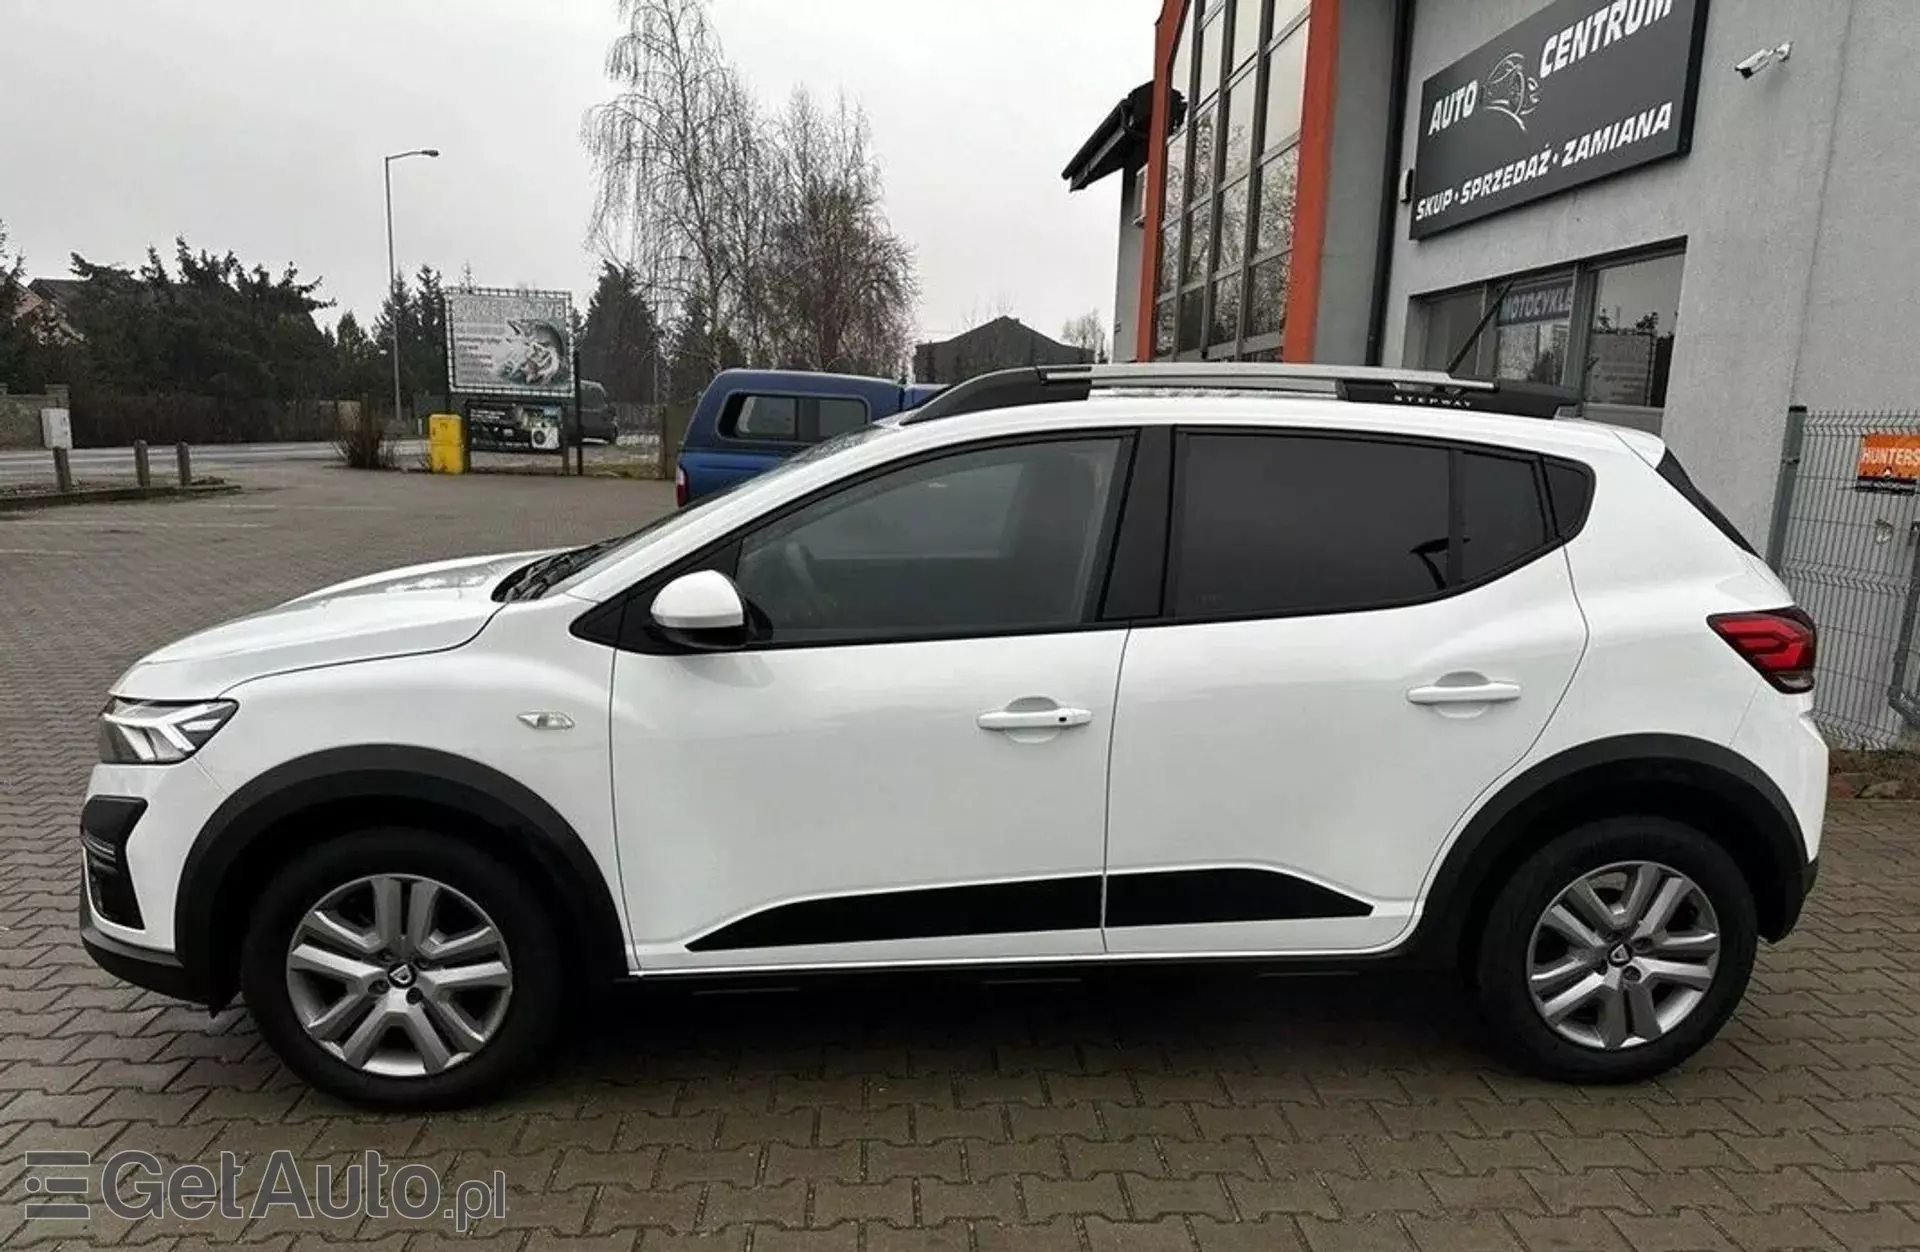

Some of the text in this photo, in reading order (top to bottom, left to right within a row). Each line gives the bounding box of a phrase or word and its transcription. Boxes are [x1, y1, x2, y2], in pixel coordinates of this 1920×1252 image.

[1428, 79, 1478, 136] AUTO
[1415, 101, 1673, 222] SKUP SPRZEDAŻ ZAMIANA
